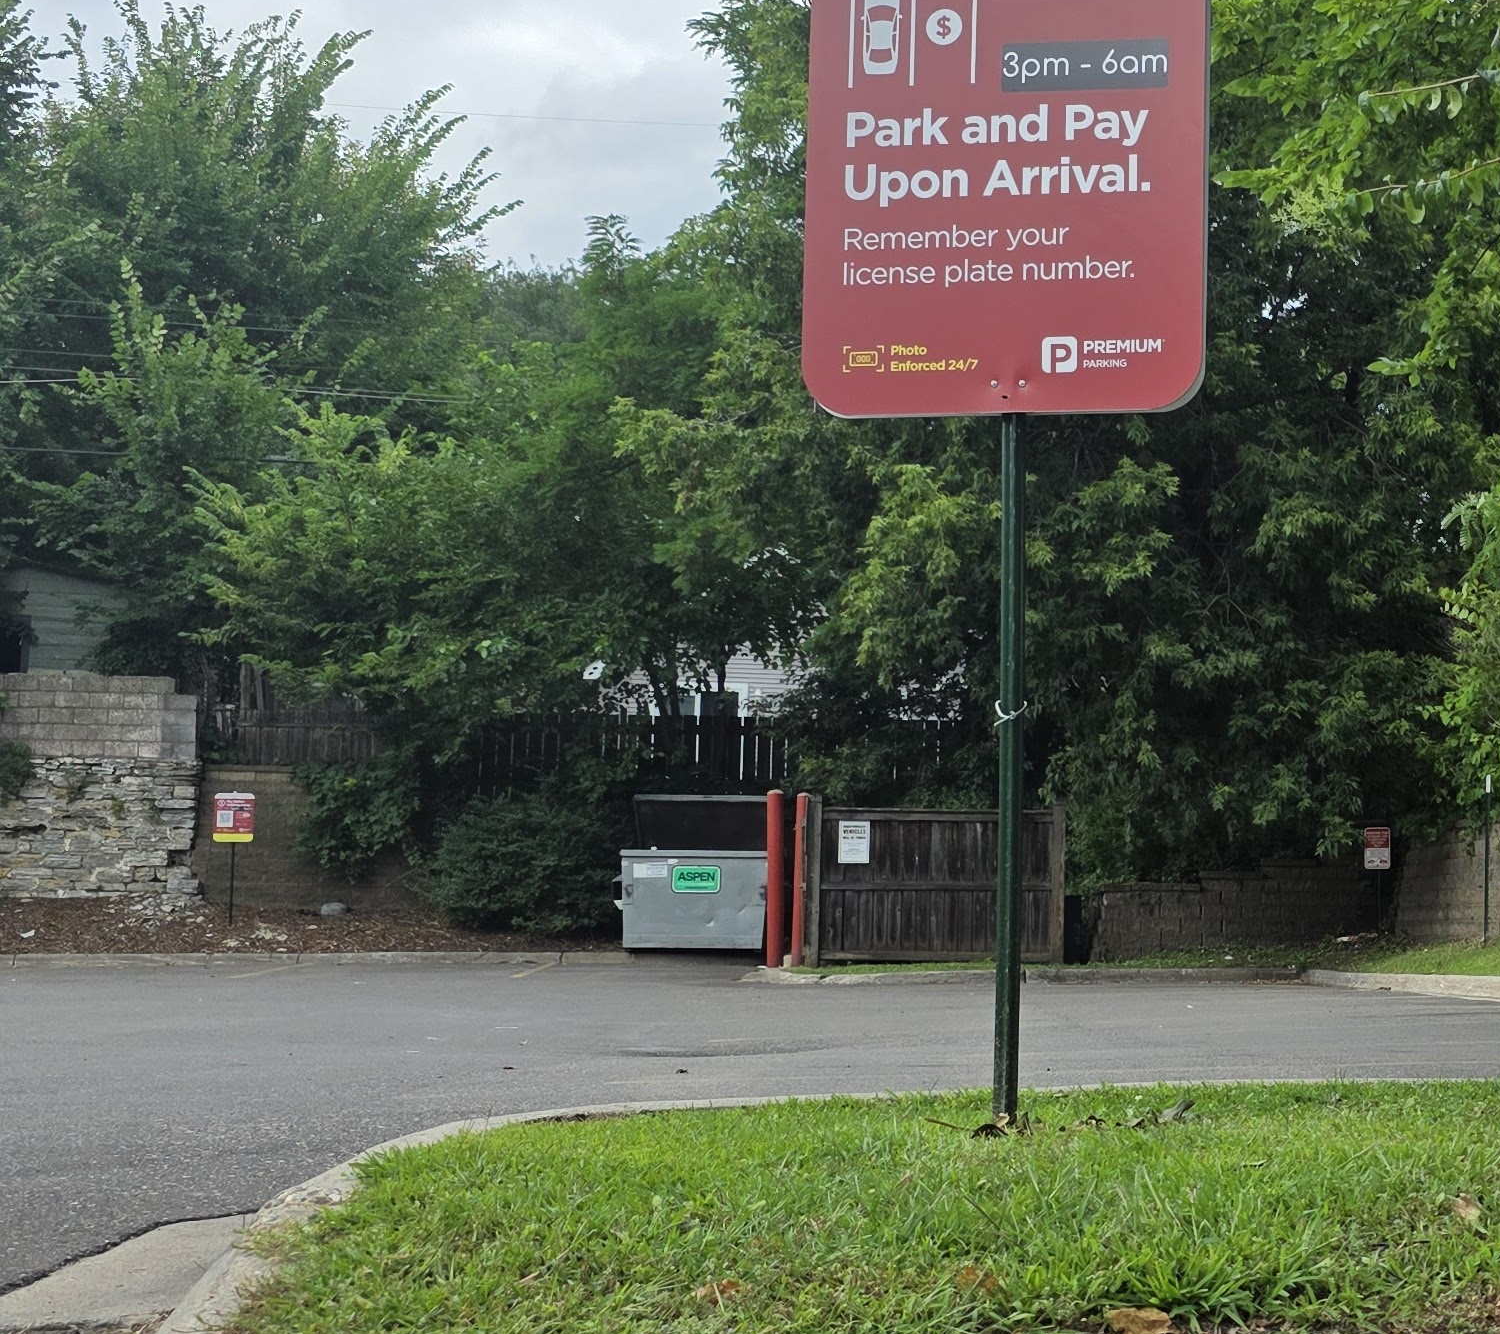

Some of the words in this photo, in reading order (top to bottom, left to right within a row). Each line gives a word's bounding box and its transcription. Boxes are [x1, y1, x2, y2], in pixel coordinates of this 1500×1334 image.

[1003, 51, 1070, 84] 3pm
[1102, 48, 1168, 76] 6am
[847, 108, 948, 147] Park
[962, 104, 1048, 144] and
[1066, 105, 1148, 146] Pay
[845, 164, 968, 207] Upon
[983, 154, 1150, 196] Arrival.
[845, 225, 998, 250] Remember
[1007, 227, 1069, 250] your
[844, 262, 935, 285] license
[945, 259, 1013, 287] plate
[1023, 256, 1134, 280] number.
[891, 344, 927, 356] Photo
[1083, 339, 1162, 353] PREMIUM
[891, 359, 945, 372] Enforced
[948, 358, 978, 372] 24/7
[1083, 359, 1127, 367] PARKING
[678, 872, 714, 881] ASPEN
